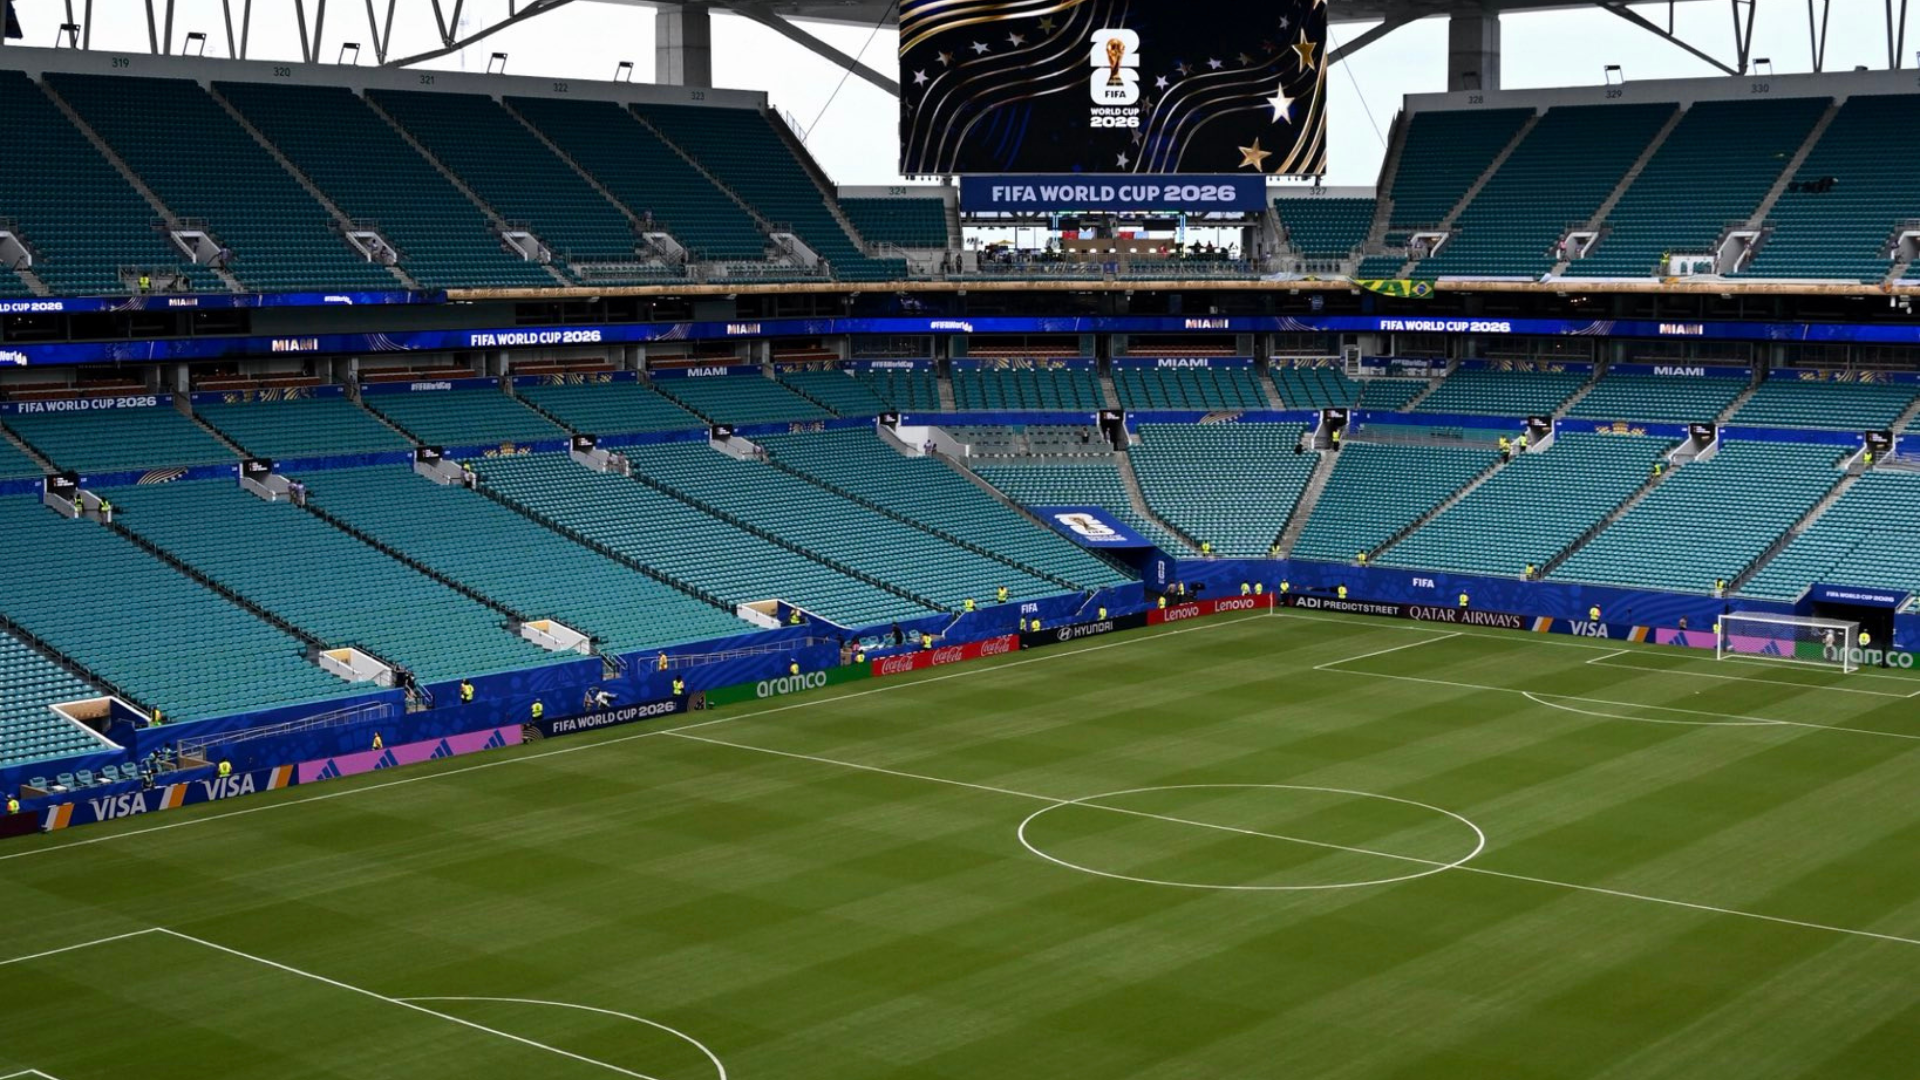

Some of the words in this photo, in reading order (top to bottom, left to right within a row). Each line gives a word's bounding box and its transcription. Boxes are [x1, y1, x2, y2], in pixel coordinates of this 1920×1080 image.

[112, 58, 129, 68] 319
[273, 67, 291, 77] 320
[420, 75, 434, 85] 321
[553, 83, 568, 92] 322
[1752, 84, 1769, 93] 330
[691, 91, 705, 100] 323
[1606, 90, 1622, 99] 329
[1090, 107, 1121, 115] WORLD
[1122, 107, 1140, 115] CUP
[1090, 116, 1140, 128] 2026
[889, 186, 907, 195] 324
[992, 186, 1037, 202] FIFA
[1040, 186, 1115, 202] WORLD
[1118, 186, 1160, 202] CUP
[1163, 185, 1236, 201] 2026
[1309, 187, 1327, 196] 327
[12, 302, 30, 311] CUP
[31, 301, 63, 311] 2026
[169, 298, 198, 306] MIAMI
[727, 323, 761, 335] MIAMI
[1185, 319, 1229, 329] MIAMI
[1380, 319, 1404, 331] FIFA
[1405, 320, 1446, 332] WORLD
[1446, 321, 1470, 332] CUP
[1470, 321, 1511, 332] 2026
[1659, 323, 1704, 335] MIAMI
[471, 333, 496, 347] FIFA
[497, 332, 538, 345] WORLD
[540, 331, 562, 343] CUP
[563, 330, 602, 343] 2026
[272, 338, 319, 352] MIAMI
[1158, 358, 1209, 367] MIAMI
[687, 366, 728, 377] MIAMI
[1653, 366, 1705, 377] MIAMI
[18, 401, 46, 413] FIFA
[47, 400, 90, 411] WORLD
[91, 399, 115, 410] CUP
[116, 396, 157, 408] 2026
[1413, 577, 1435, 588] FIFA
[1021, 603, 1038, 613] FIFA
[1214, 598, 1254, 612] Lenovo
[1296, 596, 1321, 608] ADI
[1323, 600, 1399, 615] PREDICTSTREET
[1164, 606, 1199, 621] Lenovo
[1409, 605, 1456, 622] QATAR
[1461, 611, 1520, 628] AIRWAYS
[1074, 621, 1114, 637] HYUNDAI
[1569, 619, 1609, 638] VISA
[1823, 644, 1914, 668] aramco
[757, 671, 827, 698] aramco
[553, 719, 576, 733] FIFA
[577, 713, 614, 729] WORLD
[616, 709, 637, 723] CUP
[638, 702, 674, 717] 2026
[202, 773, 255, 801] VISA
[90, 792, 147, 821] VISA
